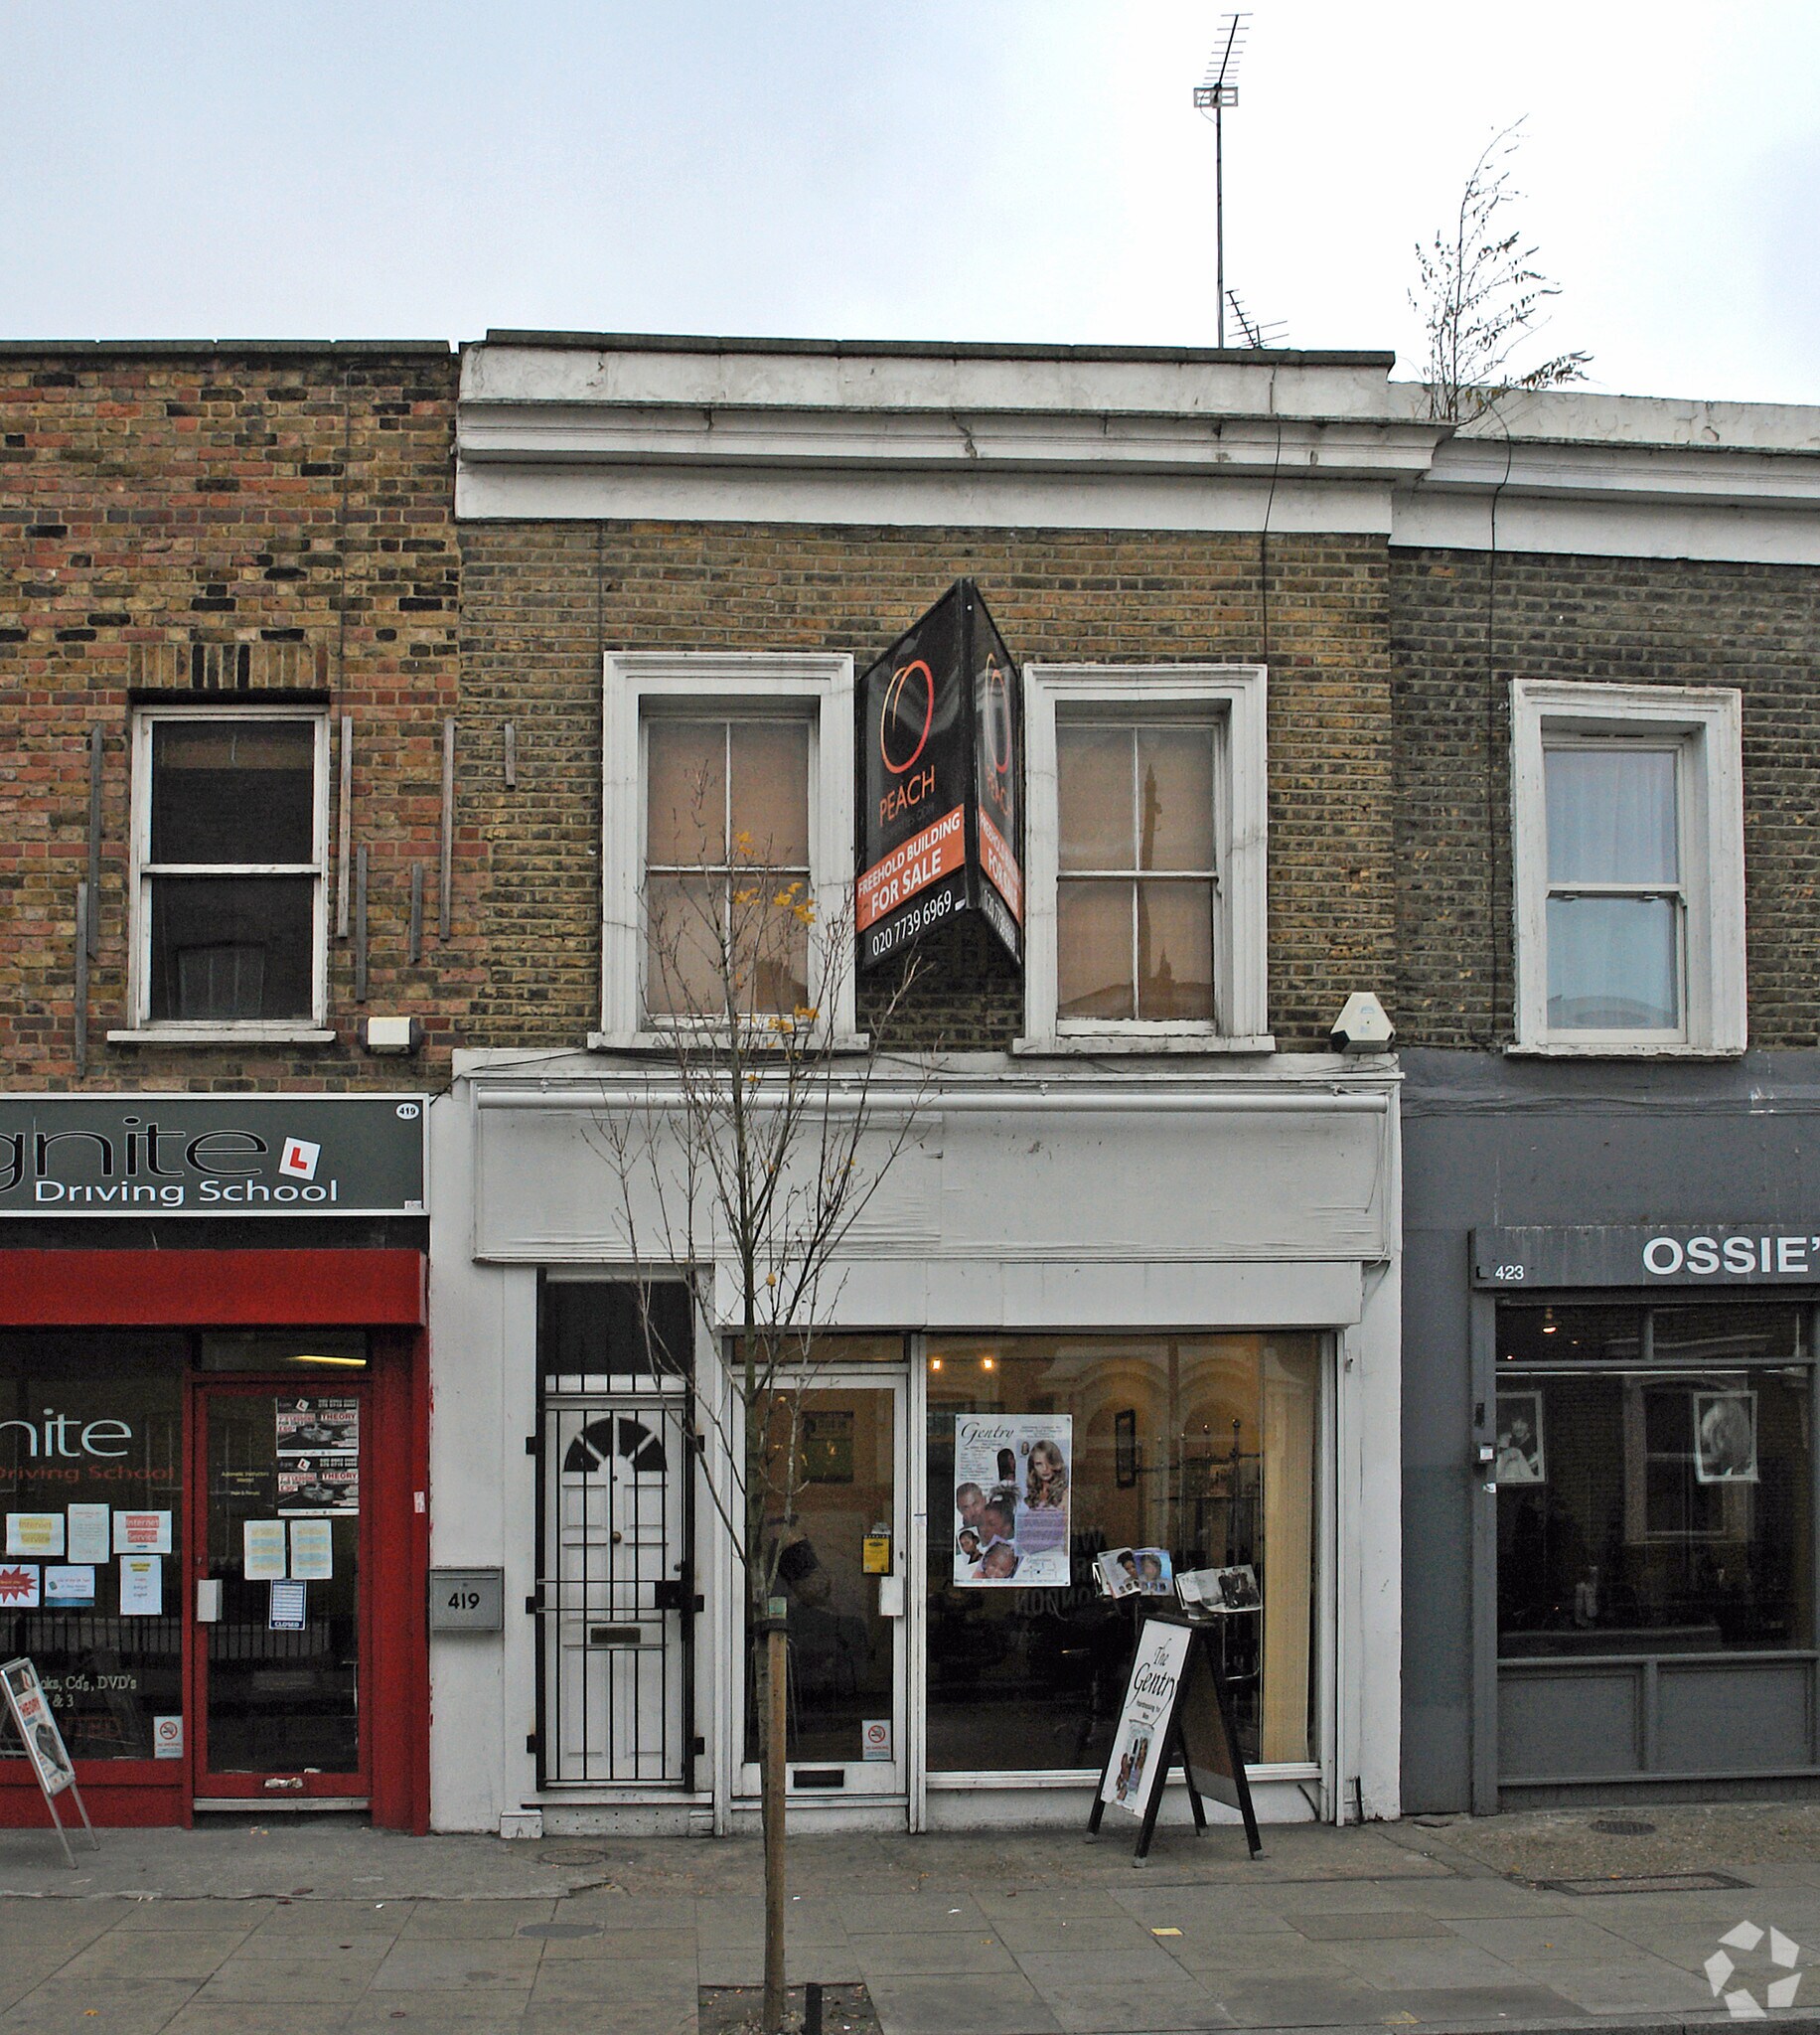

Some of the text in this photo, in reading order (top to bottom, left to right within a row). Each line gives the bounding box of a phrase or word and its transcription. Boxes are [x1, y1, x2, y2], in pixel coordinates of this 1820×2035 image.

[879, 764, 936, 827] PEACH
[857, 851, 905, 899] FREEHOLD
[906, 811, 961, 862] BUILDING
[870, 847, 943, 919] FOR SALE
[871, 889, 953, 957] 020 7739 6969
[399, 1105, 416, 1117] 419
[289, 1146, 308, 1171] L
[35, 1179, 339, 1207] Driving School
[1494, 1265, 1525, 1281] 423
[961, 1421, 1014, 1447] Gentry
[88, 1465, 175, 1481] School
[126, 1518, 160, 1528] Internet
[448, 1593, 480, 1610] 419
[96, 1674, 137, 1690] DVD's
[66, 1694, 75, 1708] 3
